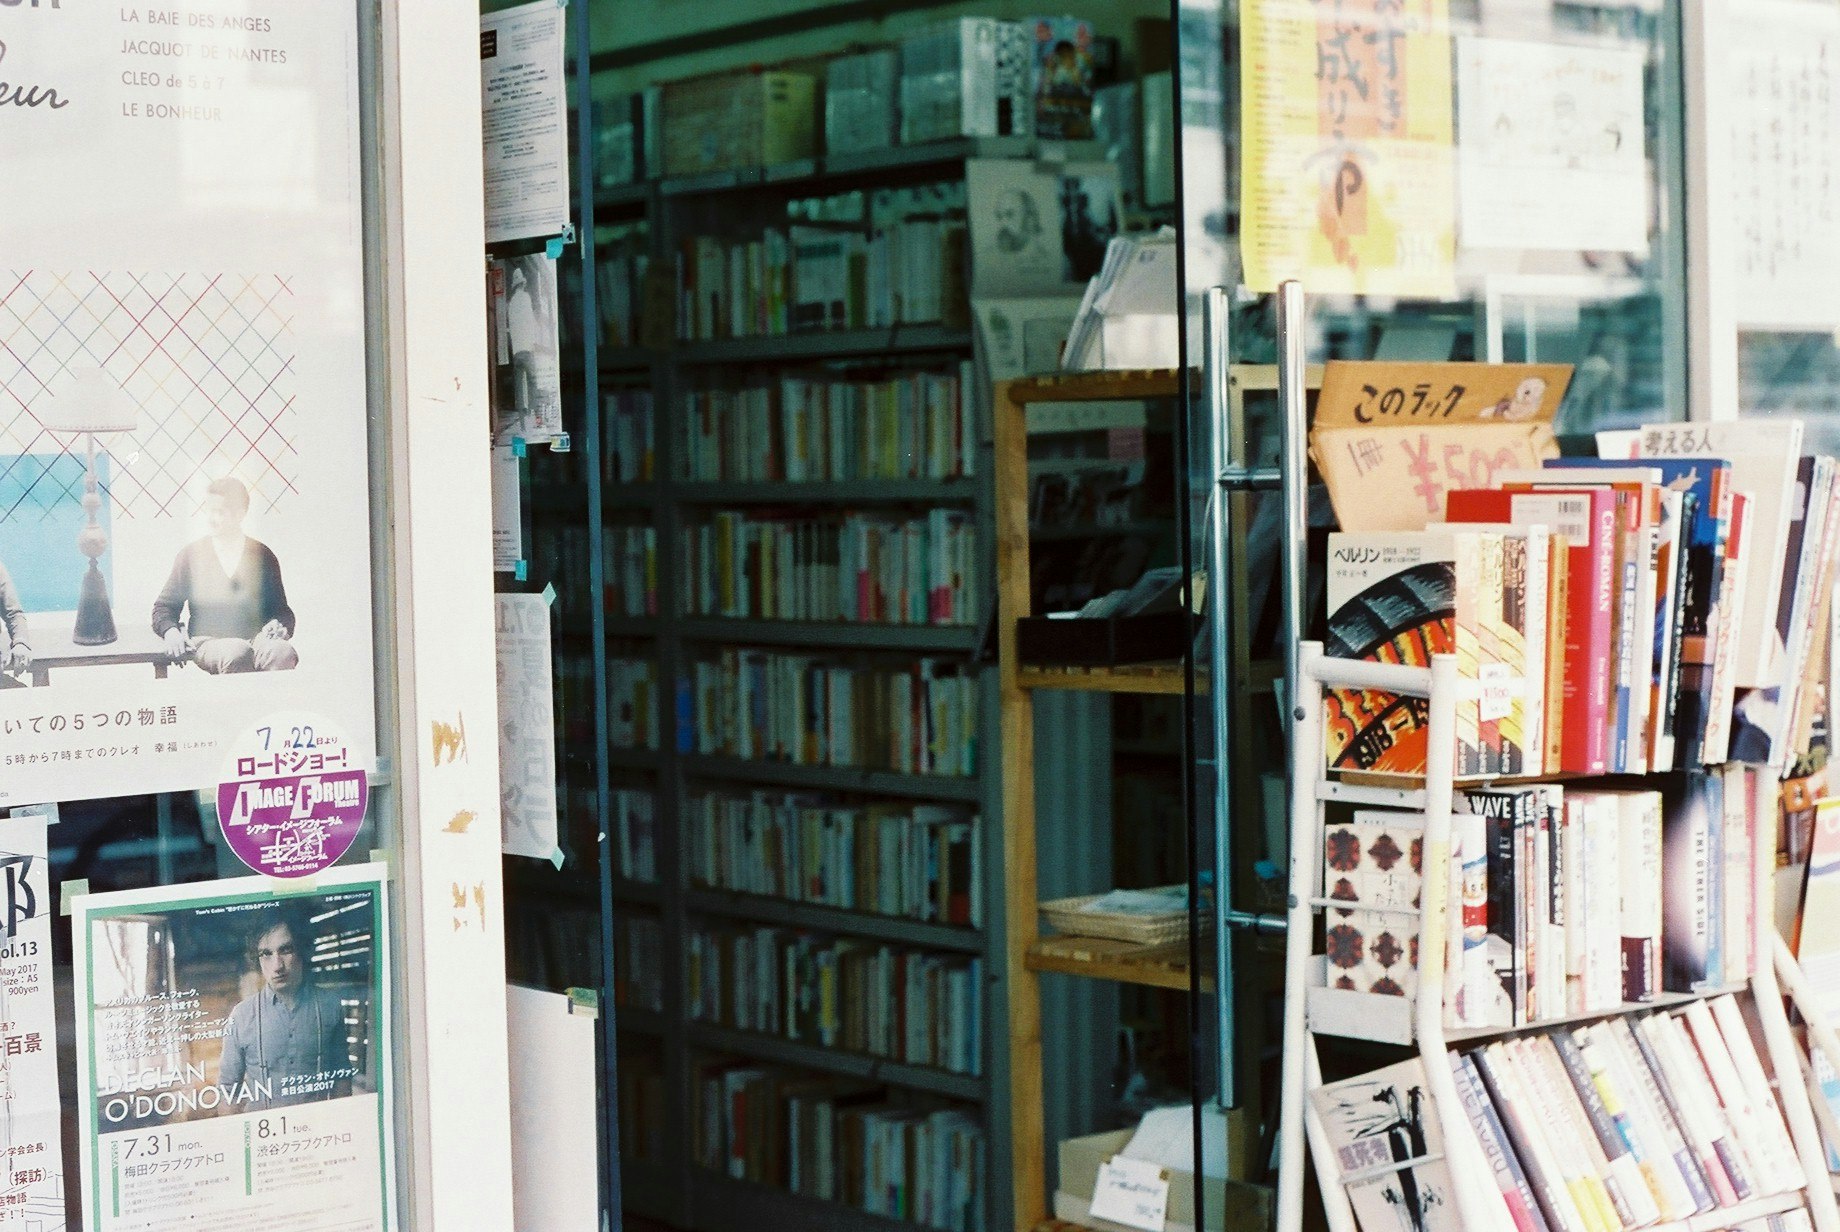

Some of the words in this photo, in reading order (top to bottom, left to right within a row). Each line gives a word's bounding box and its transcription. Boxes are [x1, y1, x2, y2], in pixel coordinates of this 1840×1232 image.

[121, 8, 139, 22] LA
[148, 10, 179, 26] BAIE
[188, 13, 214, 28] DES
[222, 16, 271, 32] ANGES
[121, 40, 192, 57] JACQUOT
[200, 45, 219, 59] DE
[228, 48, 287, 64] NANTES
[121, 71, 160, 87] CLEO
[166, 73, 182, 88] de
[188, 76, 197, 88] 5
[217, 77, 225, 90] 7
[122, 103, 138, 117] LE
[146, 104, 222, 122] BONHEUR
[1354, 384, 1466, 423] このラック
[1645, 429, 1713, 456] 考える人
[1334, 547, 1381, 563] ベルリン
[154, 741, 178, 753] 幸福
[228, 782, 294, 827] IMAGE
[289, 775, 360, 820] FORUM
[1471, 796, 1511, 819] WAVE
[1695, 832, 1705, 854] THE
[17, 963, 38, 974] 2017
[8, 985, 39, 996] 900yen
[0, 1033, 42, 1056] 百景
[105, 1060, 206, 1096] DECLAN
[280, 1067, 359, 1087] デクラン・オドノヴァン
[281, 1080, 335, 1097] 来日公演2017
[105, 1077, 273, 1123] O'DONOVAN
[258, 1115, 287, 1139] 8.1
[293, 1124, 312, 1134] tue.
[124, 1134, 172, 1160] 7.31
[178, 1141, 203, 1152] mon.
[256, 1132, 352, 1158] 渋谷クラブクアトロ
[124, 1153, 225, 1179] 梅田クラブクアトロ
